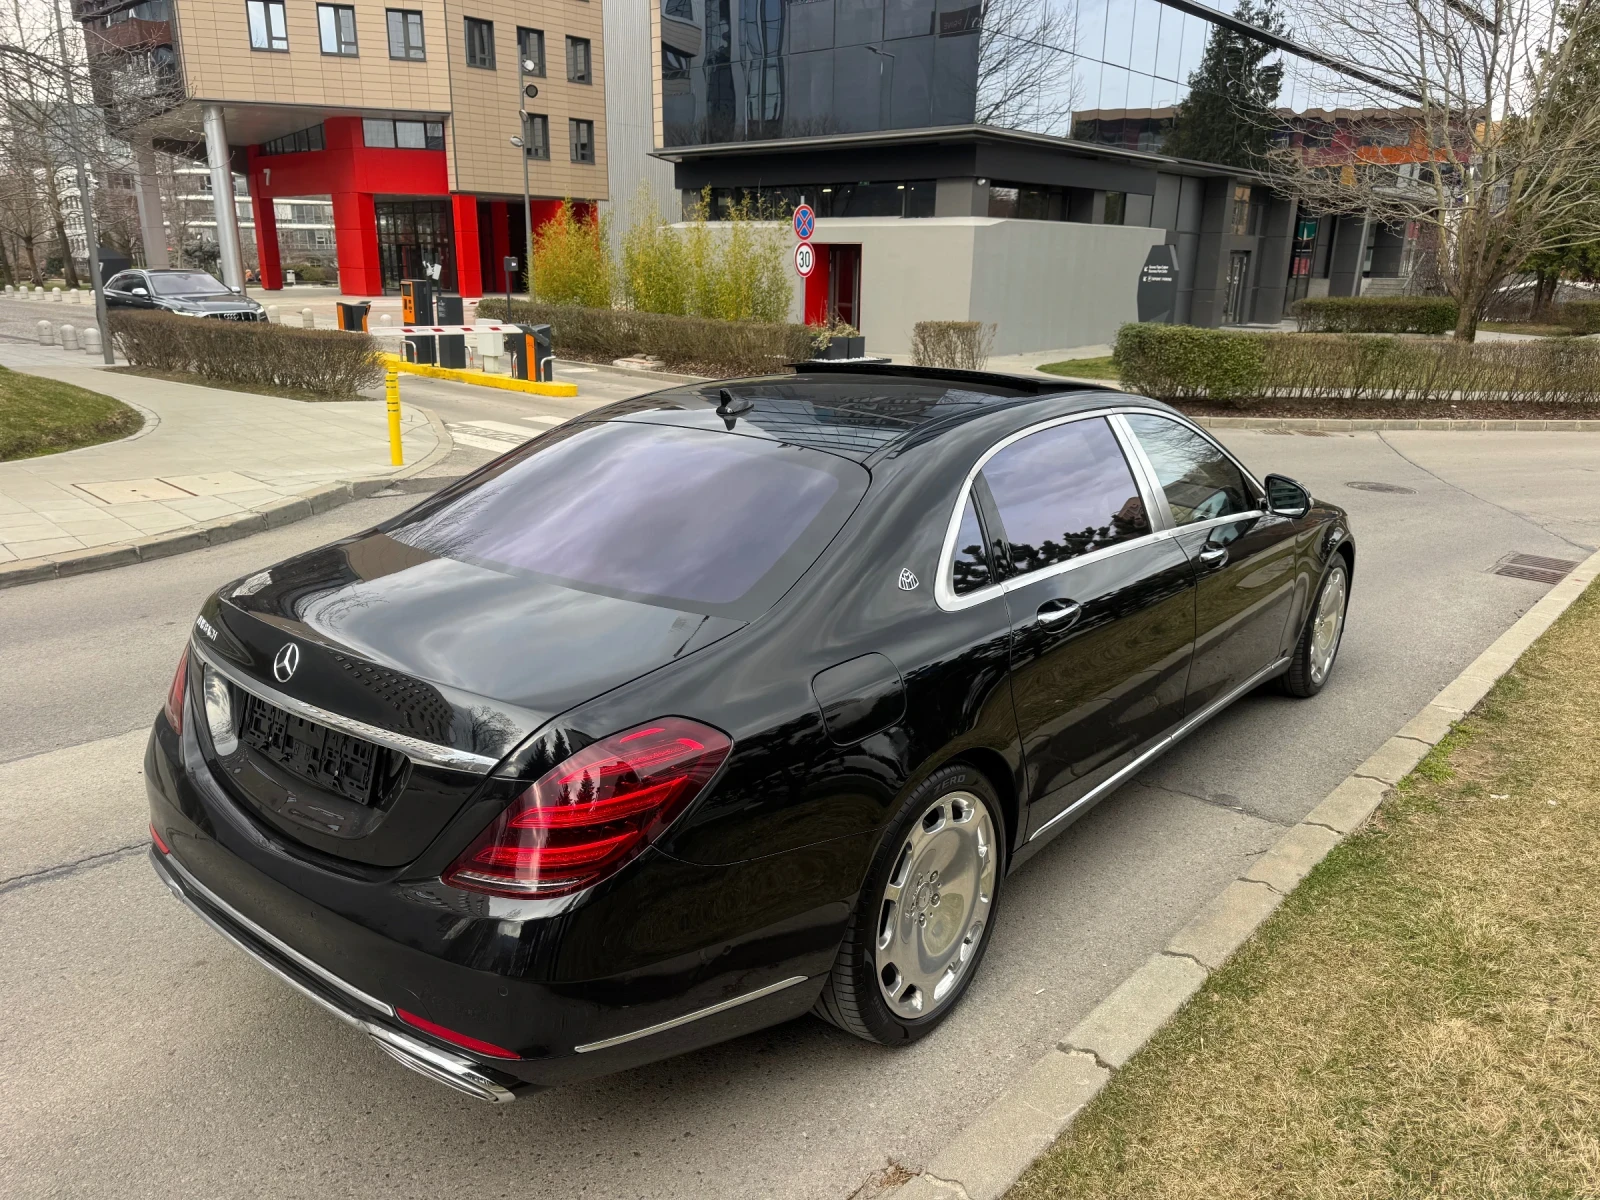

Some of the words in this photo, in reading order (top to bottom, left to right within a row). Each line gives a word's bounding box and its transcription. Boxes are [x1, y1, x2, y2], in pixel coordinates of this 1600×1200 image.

[263, 168, 271, 186] 7
[798, 251, 811, 268] 30
[933, 774, 966, 796] ZERO
